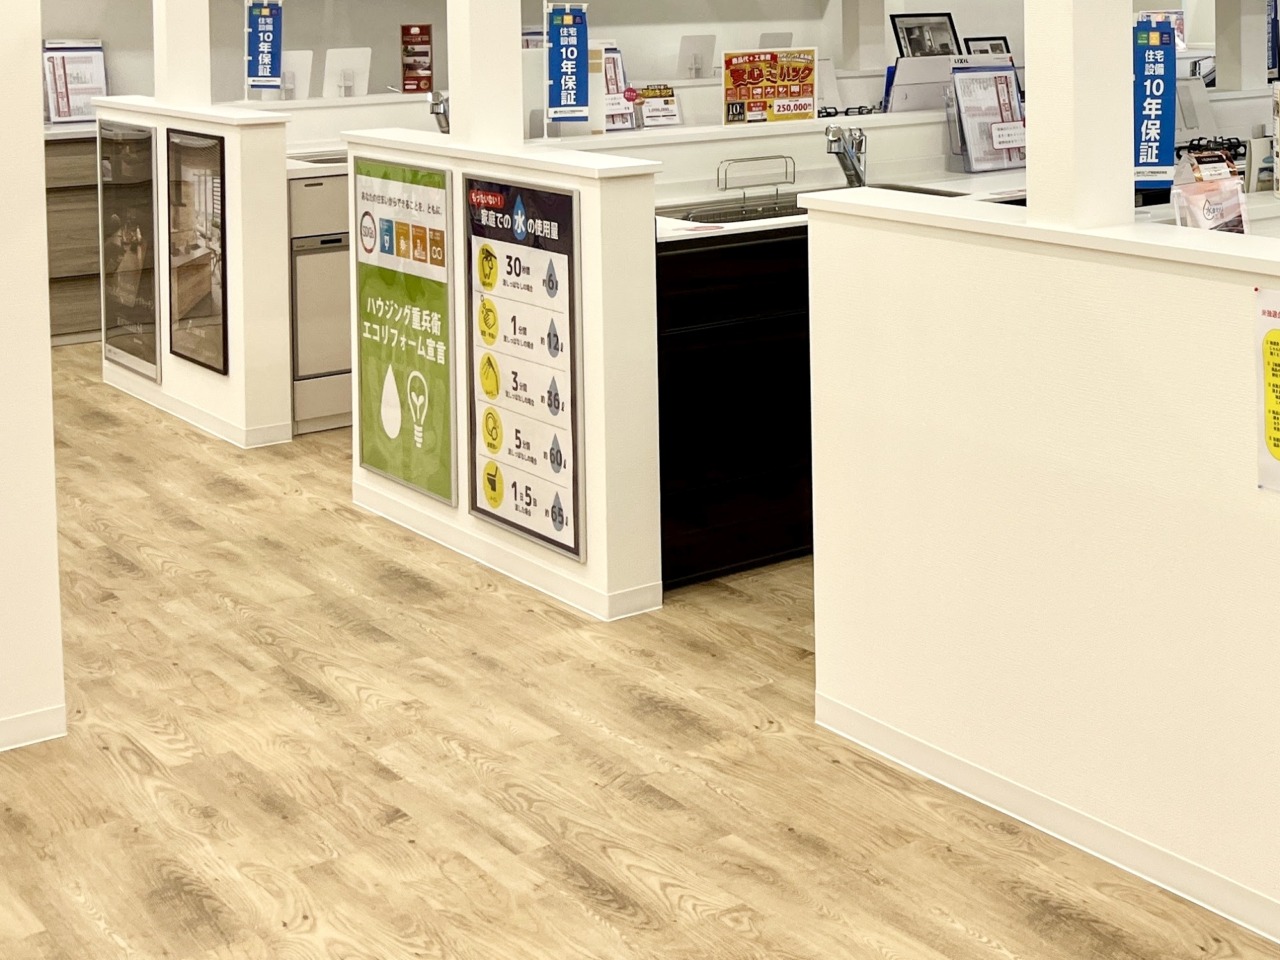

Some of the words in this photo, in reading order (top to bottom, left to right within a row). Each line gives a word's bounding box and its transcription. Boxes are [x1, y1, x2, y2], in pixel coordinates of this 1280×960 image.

[560, 27, 577, 36] 住宅
[258, 32, 273, 76] 10年保証
[1145, 50, 1164, 62] 住宅
[1145, 63, 1165, 75] 設備
[560, 47, 578, 105] 10年保証
[1139, 79, 1164, 164] 10年保証
[367, 297, 442, 336] ハウジング重兵衛
[363, 321, 446, 365] エコリフォーム宣言
